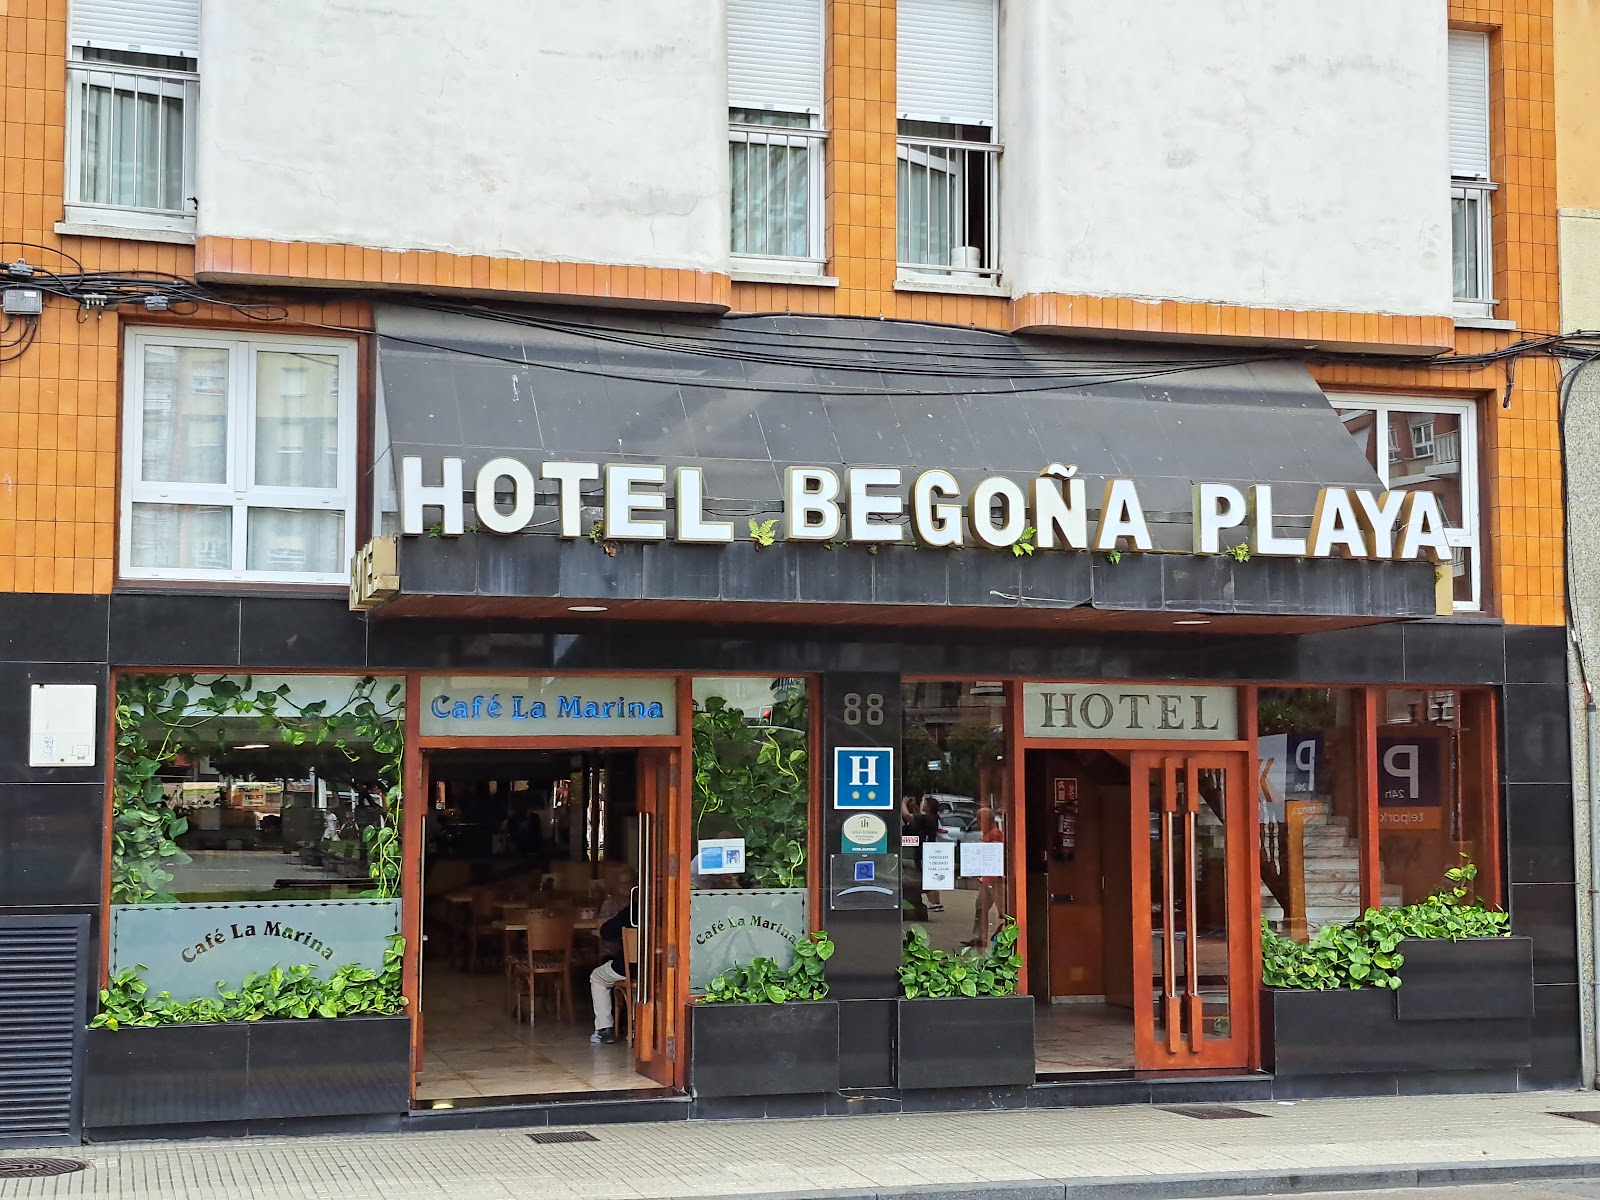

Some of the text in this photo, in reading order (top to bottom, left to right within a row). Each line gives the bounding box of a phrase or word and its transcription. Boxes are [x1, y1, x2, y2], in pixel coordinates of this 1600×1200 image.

[402, 455, 1453, 562] HOTEL BEGOÑA PLAYA
[431, 693, 664, 720] Café La Marina
[843, 693, 884, 725] 88
[1040, 692, 1219, 731] HOTEL
[849, 755, 879, 786] H
[181, 920, 334, 963] Café La Marina
[695, 914, 797, 945] Café La Marina
